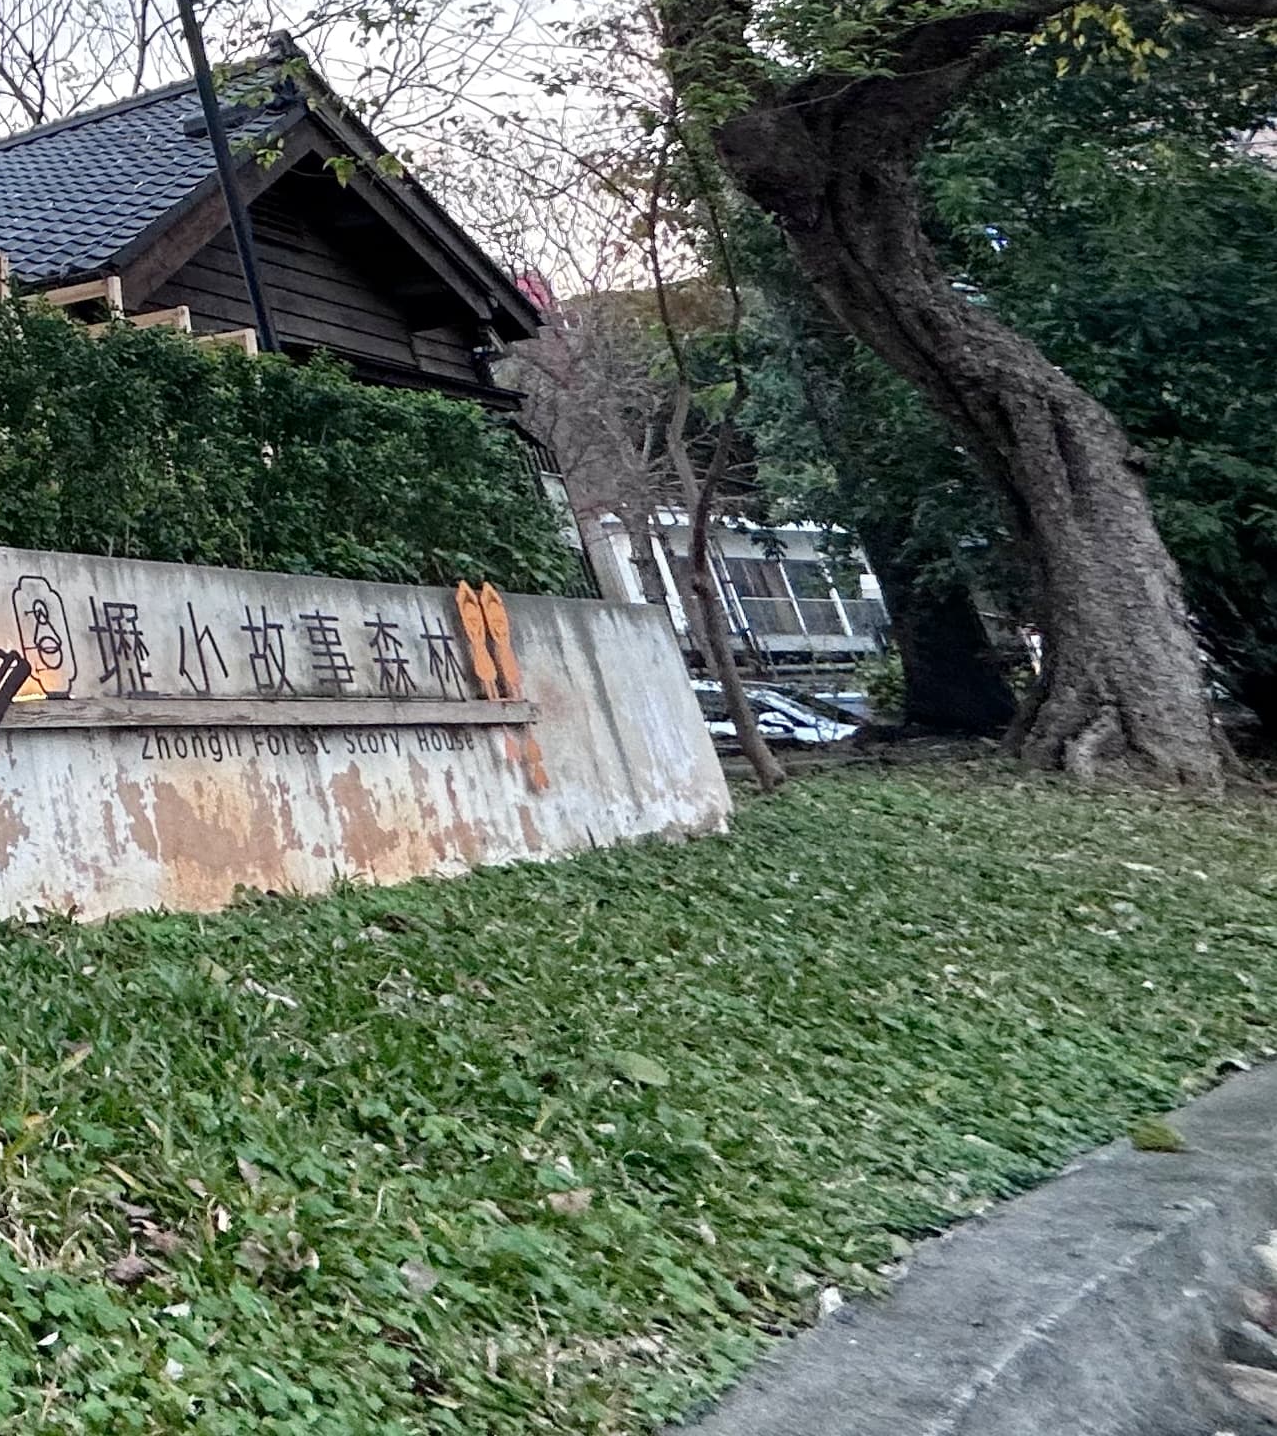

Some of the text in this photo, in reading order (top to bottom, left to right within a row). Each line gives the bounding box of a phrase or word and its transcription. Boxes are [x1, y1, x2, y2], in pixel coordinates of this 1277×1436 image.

[88, 596, 467, 702] 壢小故事森林
[252, 728, 331, 756] Forest
[343, 728, 401, 756] Story
[414, 727, 475, 752] House
